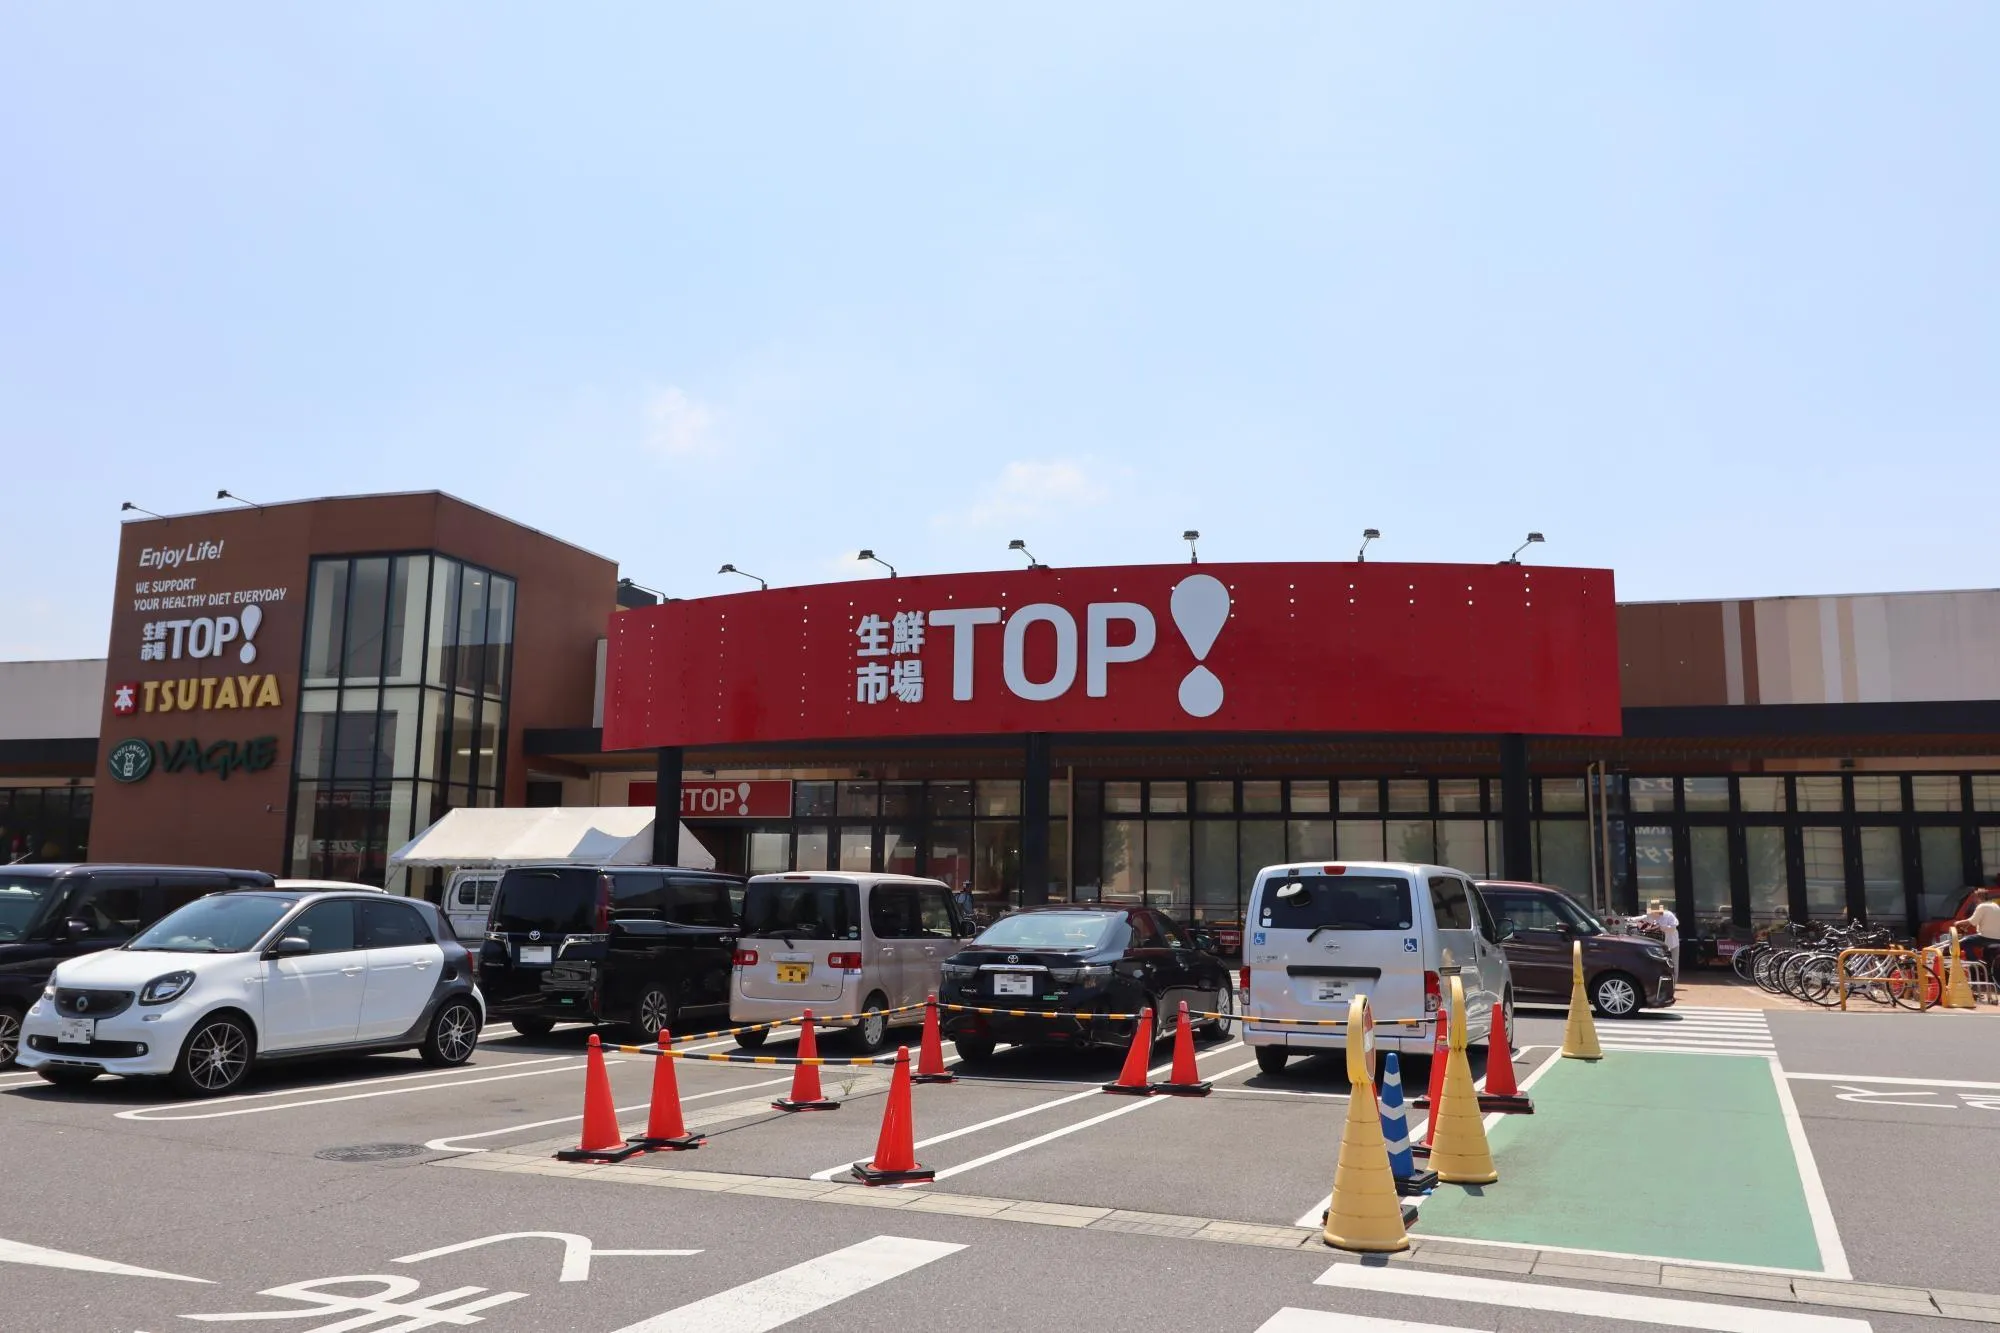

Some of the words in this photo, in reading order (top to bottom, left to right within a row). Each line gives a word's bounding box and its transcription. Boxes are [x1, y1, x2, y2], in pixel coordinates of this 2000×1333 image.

[139, 547, 185, 570] Enjoy
[186, 540, 224, 562] Life!
[134, 598, 159, 611] YOUR
[162, 594, 206, 609] HEALTHY
[209, 592, 231, 606] DIET
[234, 588, 287, 603] EVERYDAY
[136, 581, 149, 594] WE
[152, 578, 196, 593] SUPPORT
[856, 610, 925, 656] 生鮮
[114, 685, 133, 712] 本
[143, 674, 282, 713] TSUTAYA
[856, 659, 924, 705] 市場
[157, 736, 278, 781] VAGUE
